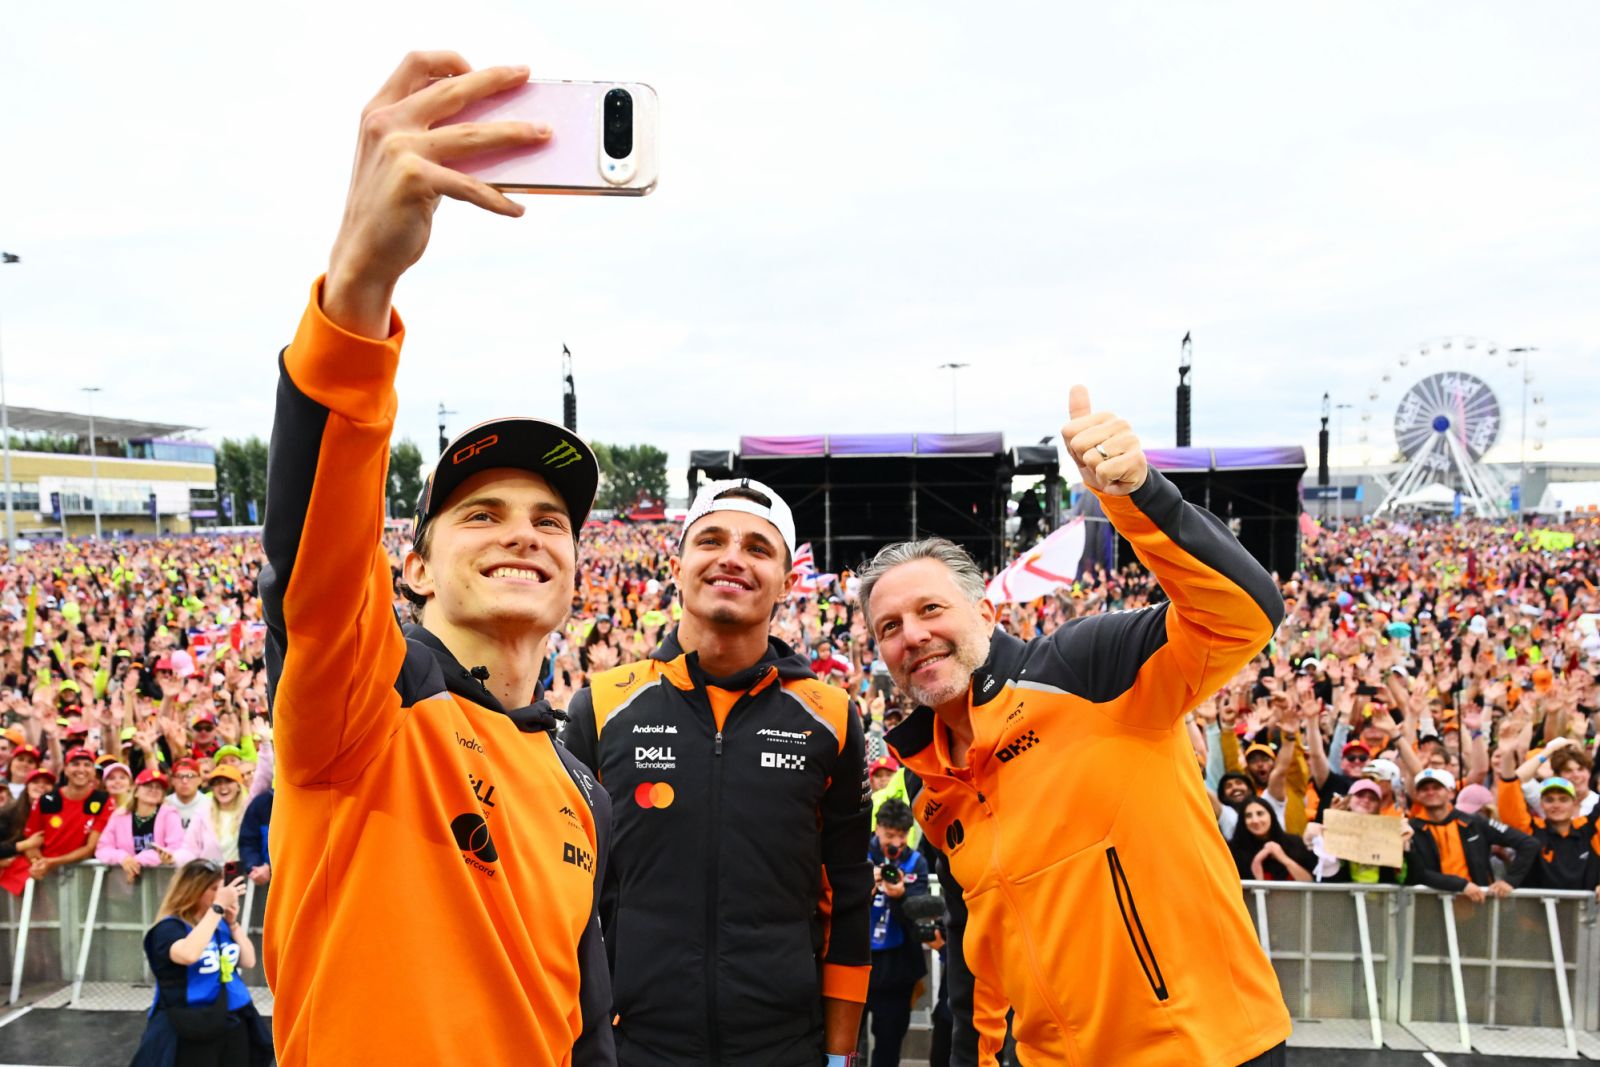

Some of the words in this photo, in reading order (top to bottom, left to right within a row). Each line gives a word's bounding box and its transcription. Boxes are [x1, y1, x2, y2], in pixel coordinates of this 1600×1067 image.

[453, 434, 498, 465] OP
[632, 724, 664, 733] Android
[756, 729, 806, 739] McLaren
[635, 746, 676, 761] DELL
[995, 730, 1040, 763] OKX
[634, 761, 676, 770] Technologies
[761, 752, 806, 770] OKX
